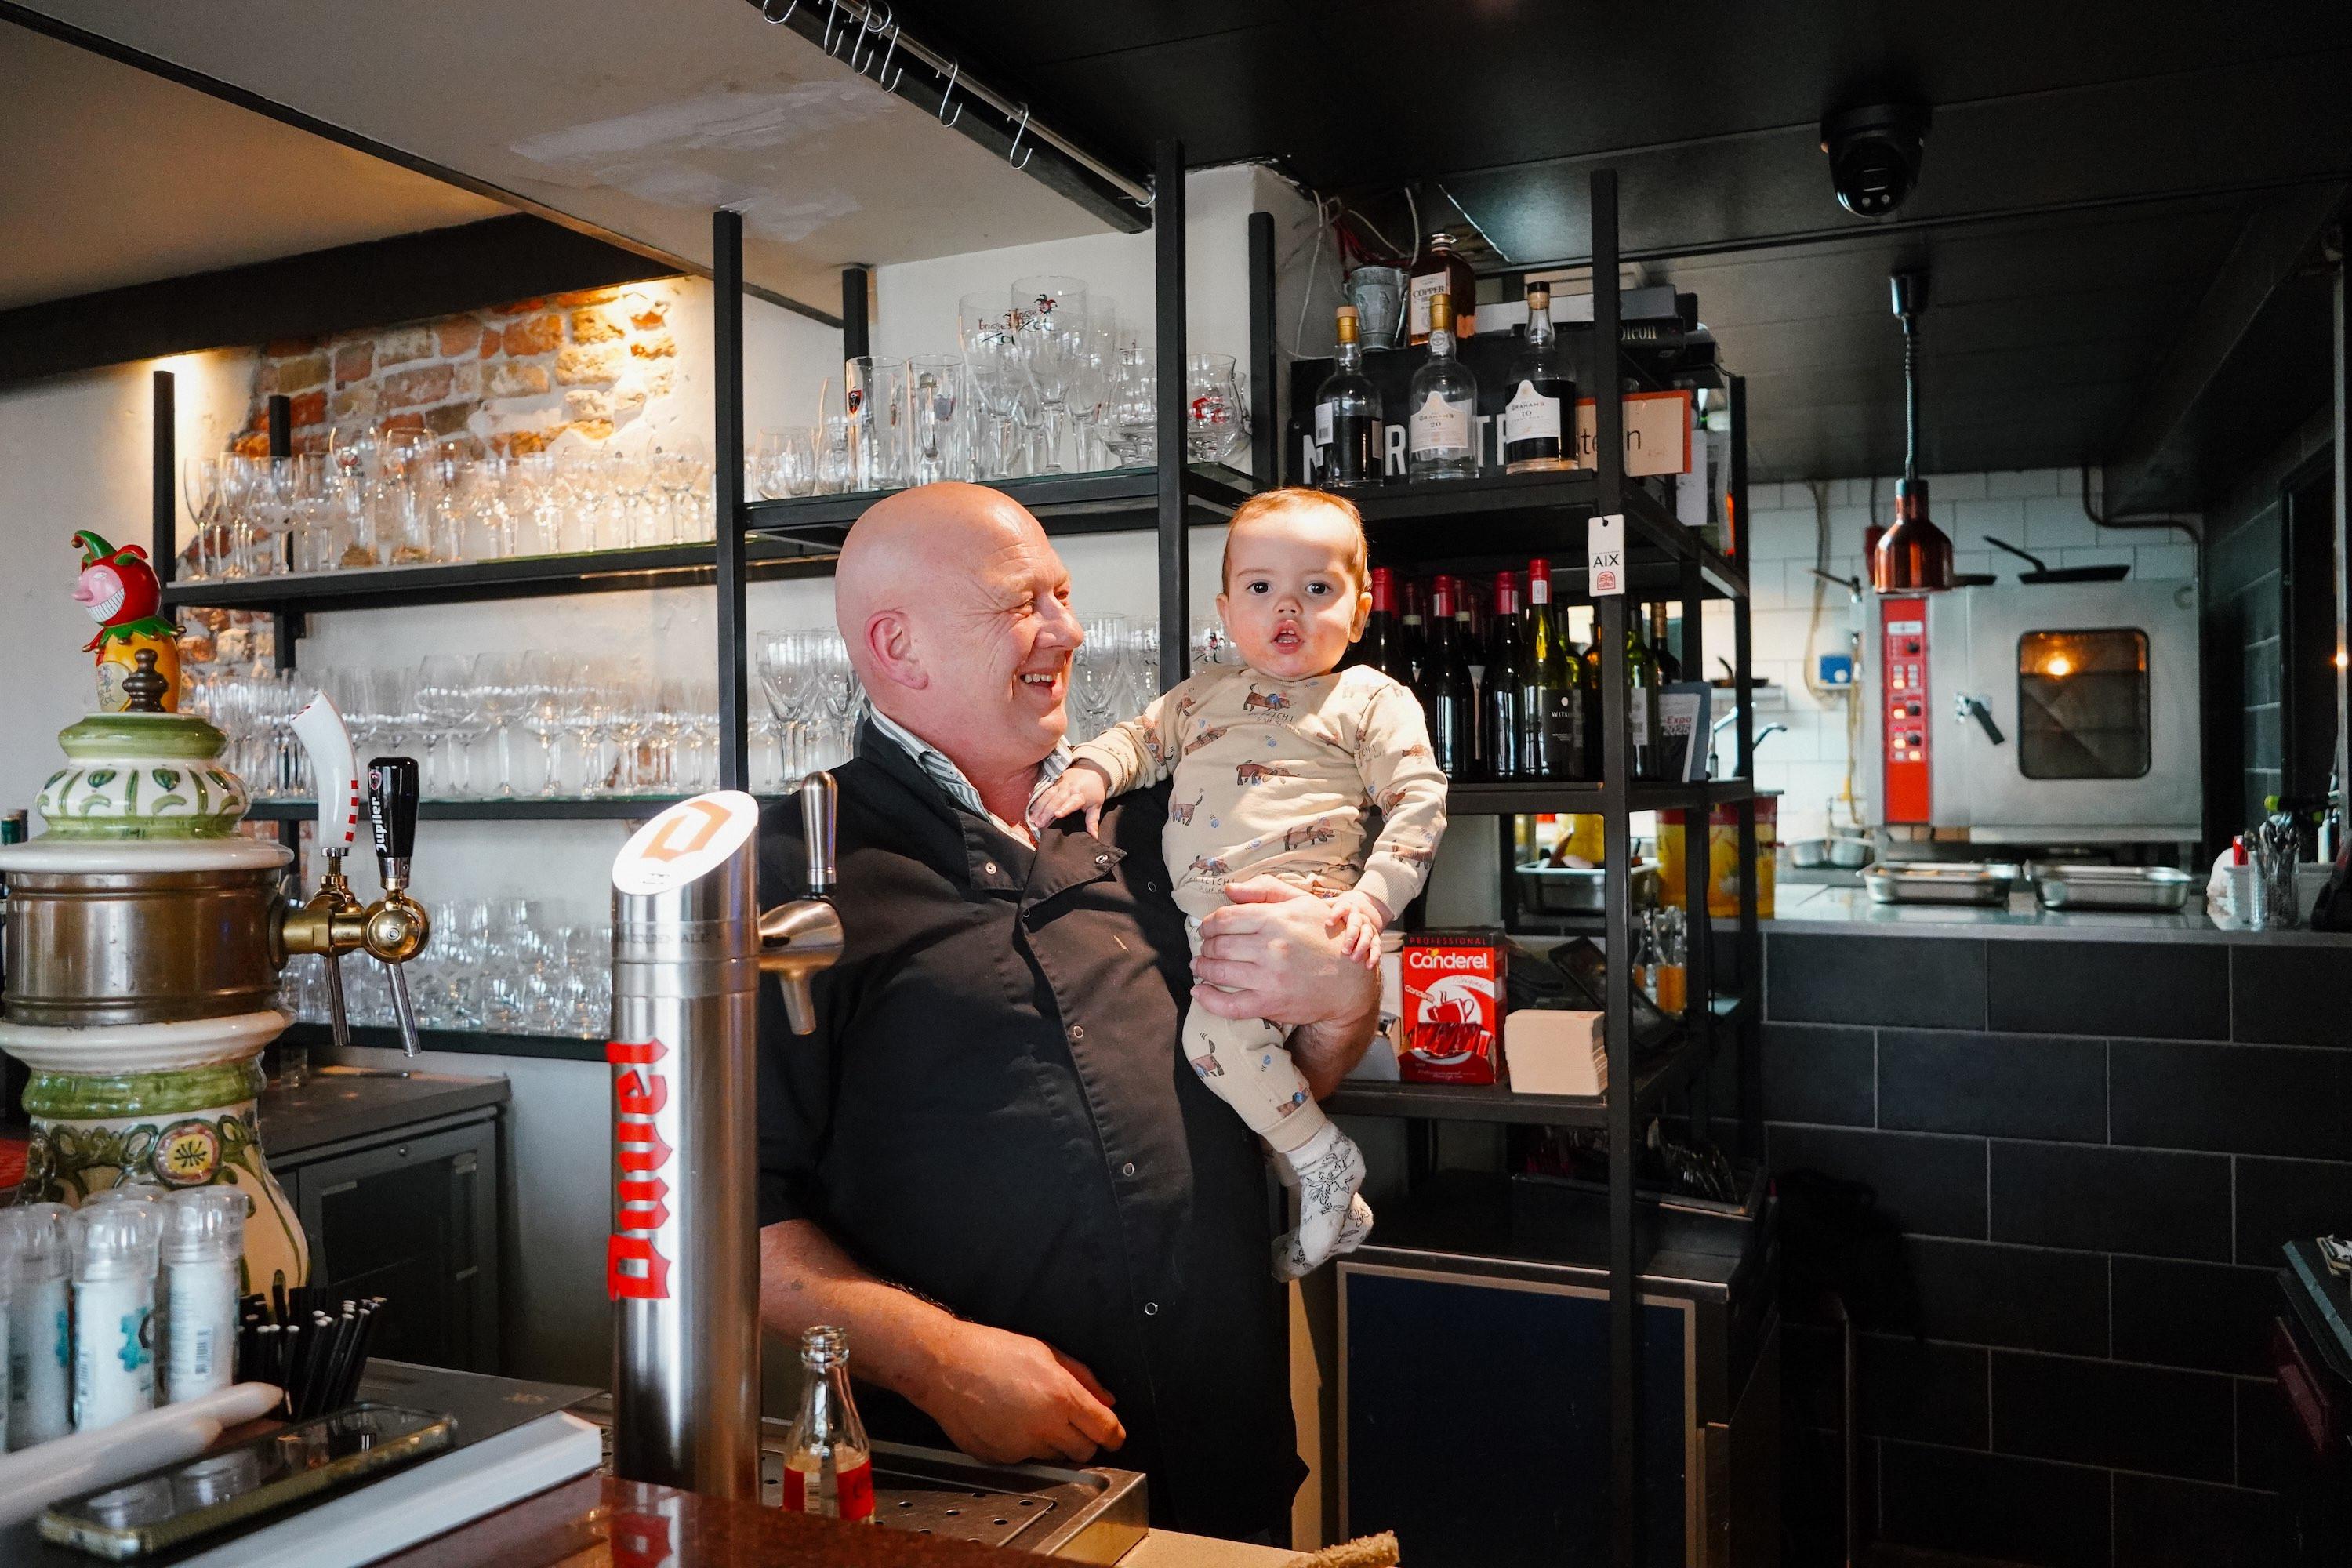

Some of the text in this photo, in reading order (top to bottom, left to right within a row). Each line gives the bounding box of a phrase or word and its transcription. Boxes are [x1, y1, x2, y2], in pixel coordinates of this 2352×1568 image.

[1413, 285, 1444, 298] COPPER
[1593, 554, 1619, 568] AIX
[1666, 715, 1691, 725] Expo
[372, 797, 388, 853] Jupiler
[1410, 937, 1486, 946] PROFESSIONAL
[1410, 948, 1488, 969] Canderel
[605, 1037, 673, 1301] Duvel
